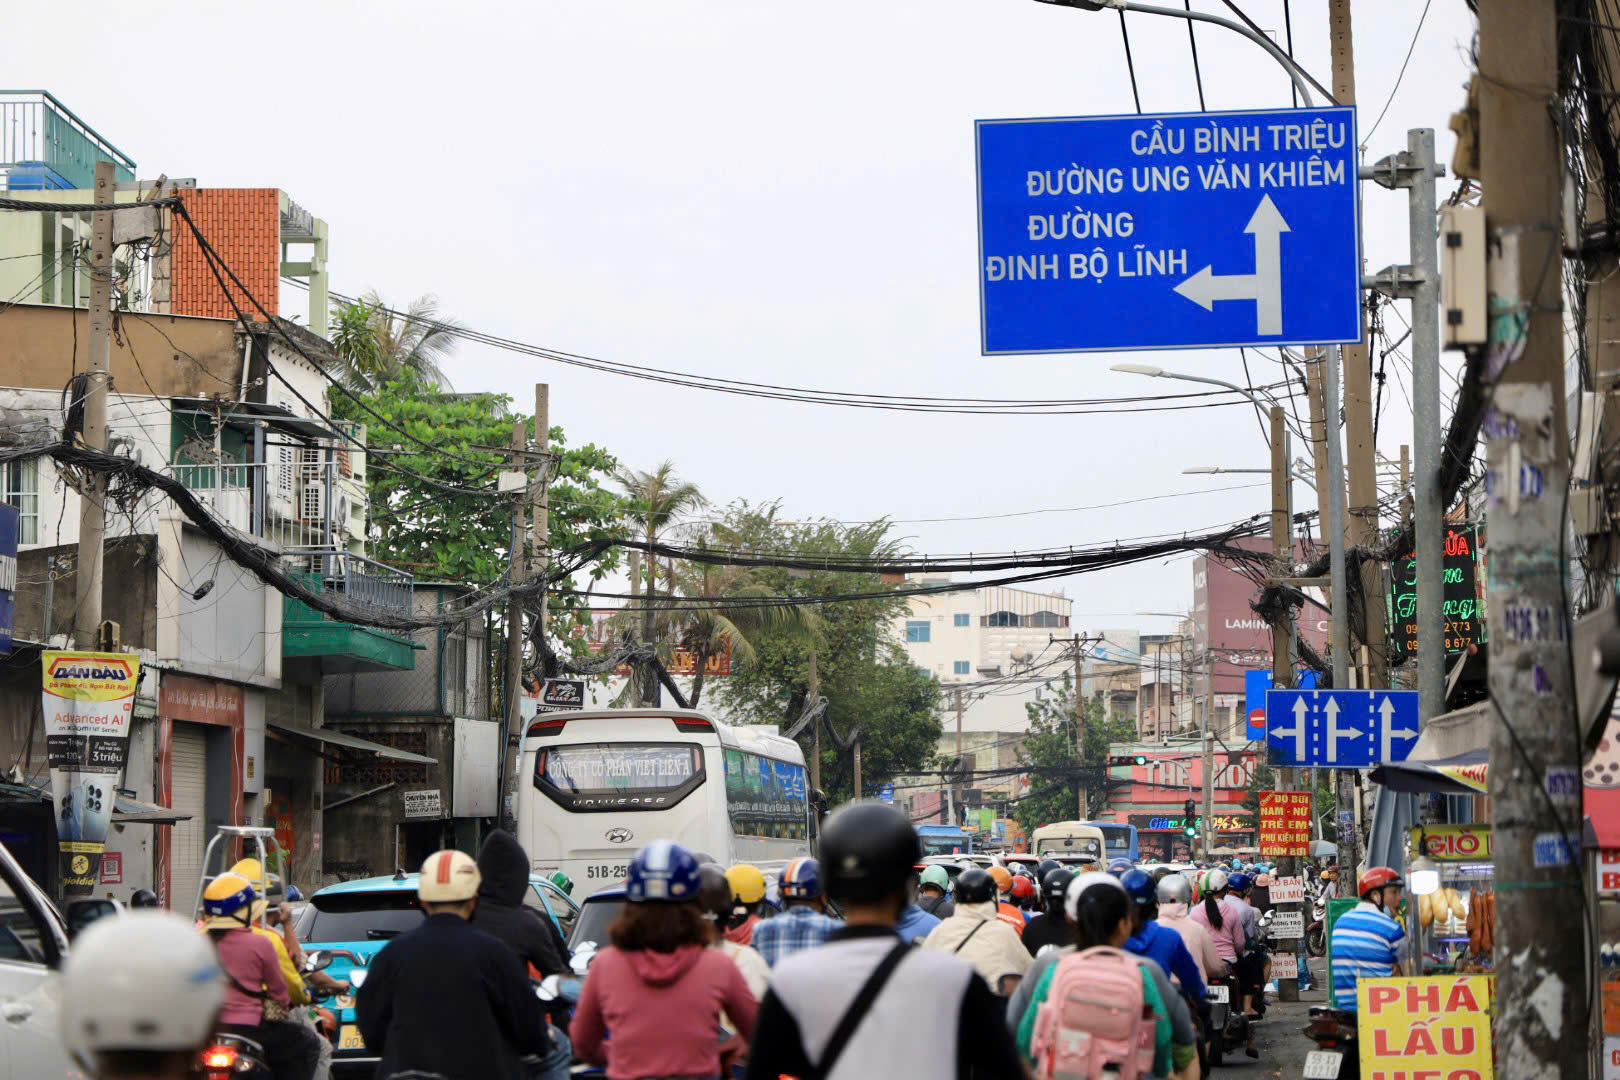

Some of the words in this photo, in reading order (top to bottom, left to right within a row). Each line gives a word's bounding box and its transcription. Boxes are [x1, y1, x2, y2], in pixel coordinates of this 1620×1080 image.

[1130, 119, 1186, 155] CẦU
[1194, 120, 1260, 153] BÌNH
[1268, 117, 1345, 153] TRIỆU
[1026, 162, 1123, 196] ĐƯỜNG
[1132, 166, 1190, 193] UNG
[1197, 157, 1251, 190] VĂN
[1259, 154, 1345, 188] KHIÊM
[1028, 205, 1134, 241] ĐƯỜNG
[985, 253, 1059, 282] ĐINH
[1069, 246, 1109, 283] BỘ
[1118, 243, 1188, 277] LĨNH
[54, 712, 109, 725] Advanced
[111, 714, 124, 725] AI
[92, 751, 99, 762] 3
[1261, 807, 1284, 816] NAM
[1288, 820, 1307, 829] EM
[587, 865, 633, 878] 51B-25
[1367, 976, 1481, 1015] PHÁ
[1373, 1016, 1476, 1057] LẤU
